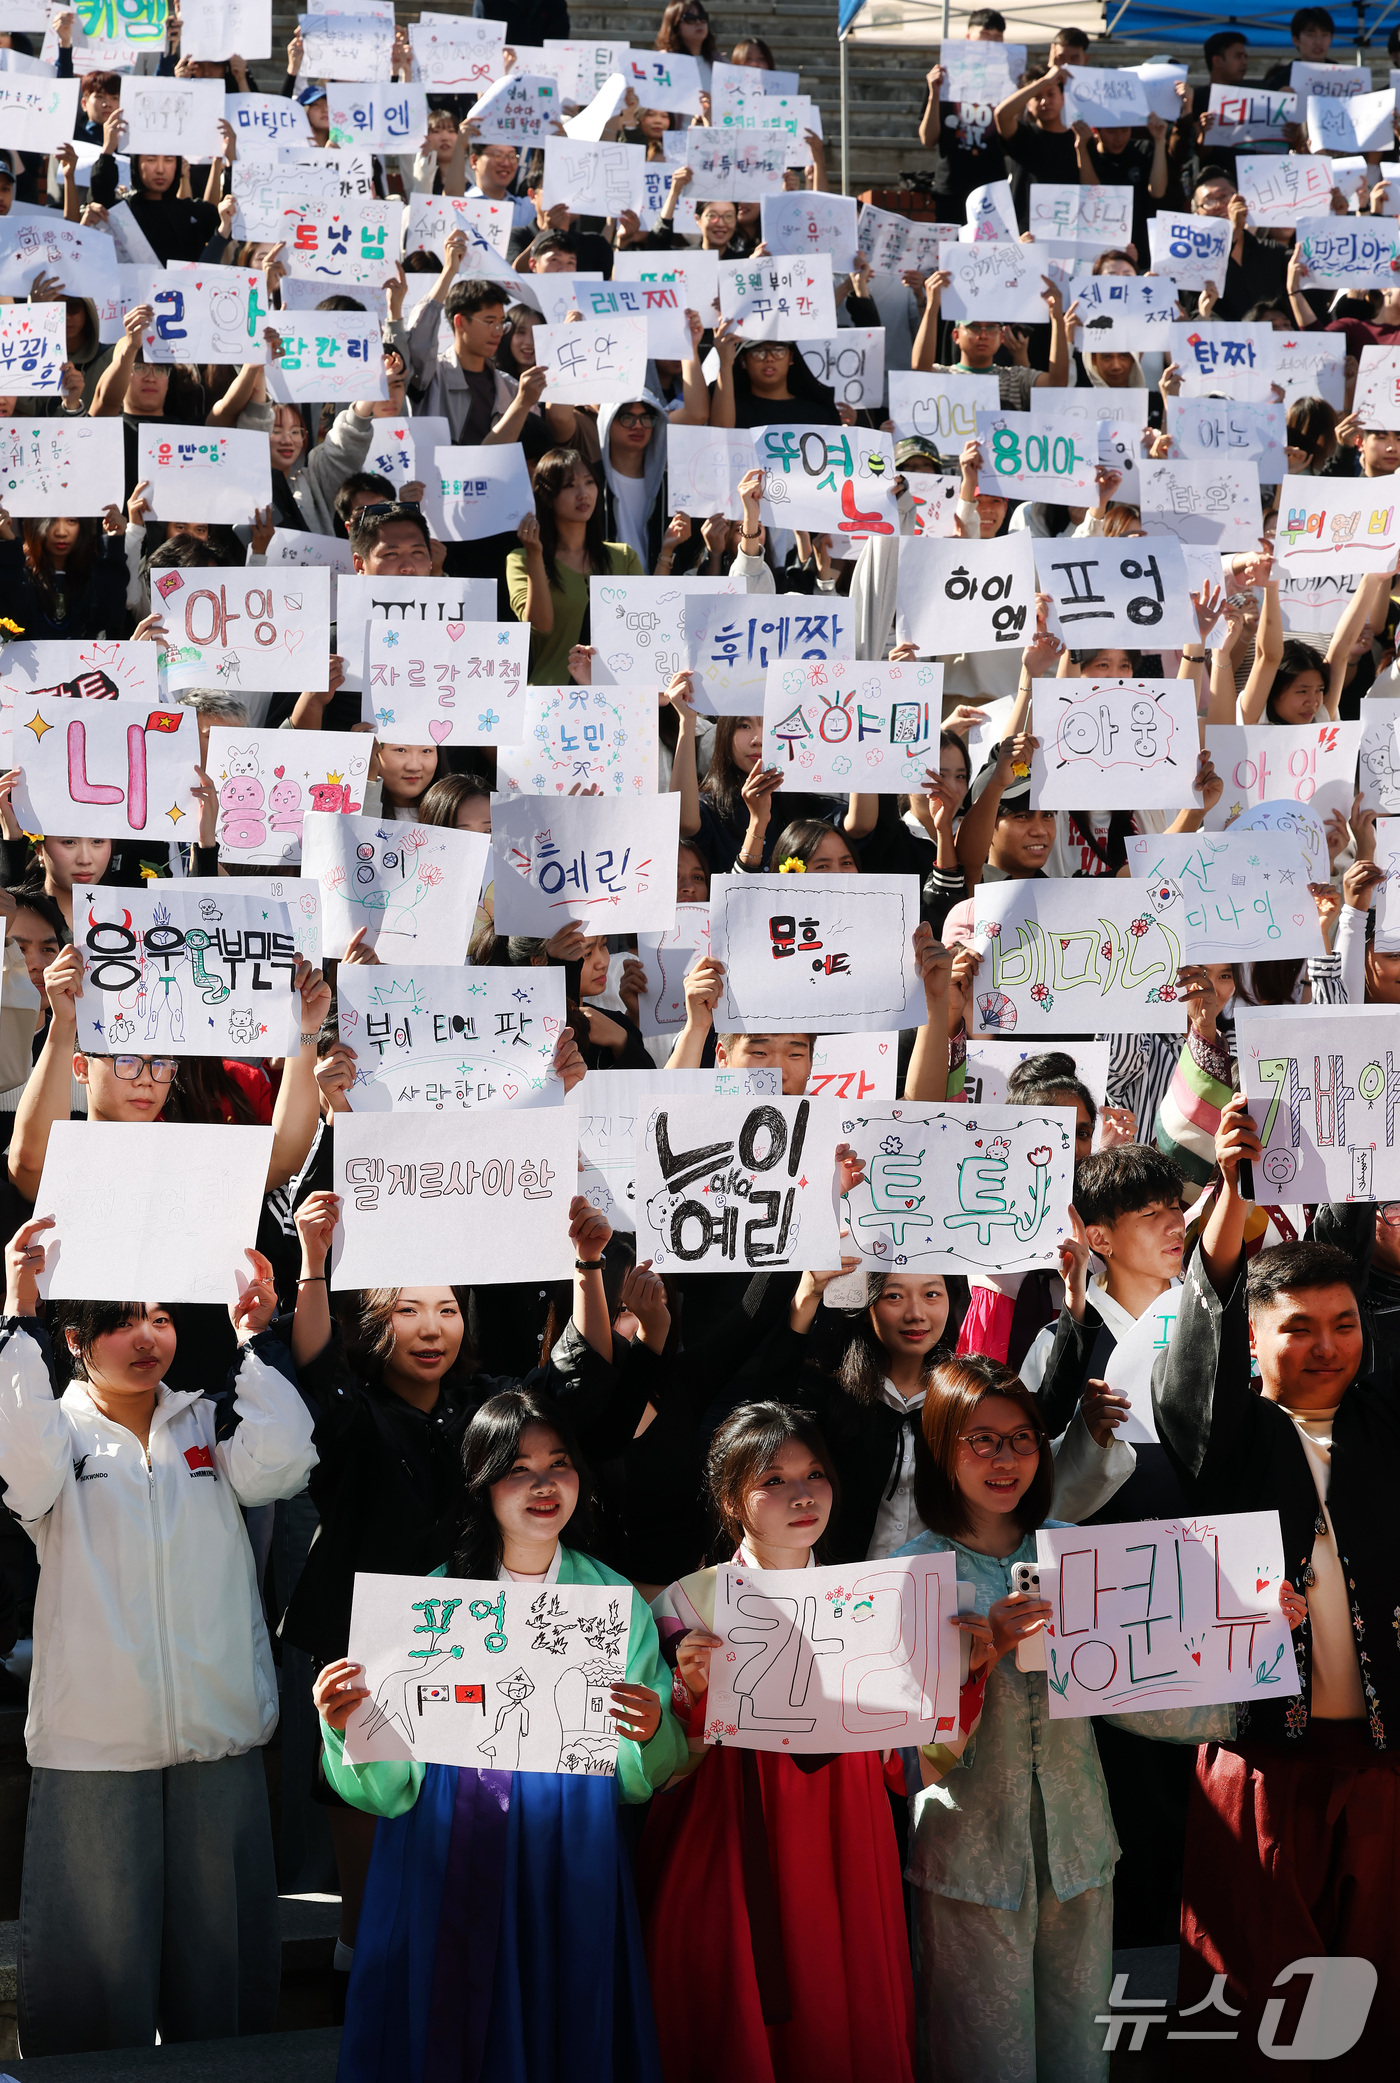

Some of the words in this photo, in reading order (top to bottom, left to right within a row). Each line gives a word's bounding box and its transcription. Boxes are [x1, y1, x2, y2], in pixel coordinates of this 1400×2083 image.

[238, 110, 297, 138] 마틸다
[294, 224, 388, 260] 도낫남
[1315, 234, 1389, 262] 마리아
[281, 336, 368, 370] 팜칸리
[1194, 341, 1256, 374] 탄짜
[1199, 420, 1250, 448] 아노
[1171, 485, 1230, 515] 타오
[1280, 506, 1326, 546] 부이
[1368, 506, 1394, 536] 비
[944, 566, 1013, 601] 하이
[185, 584, 277, 648] 아잉
[992, 605, 1027, 643] 엔
[561, 723, 604, 752] 노민
[1062, 702, 1158, 758] 아웅
[1232, 749, 1317, 802] 아잉
[537, 843, 632, 894] 혜린
[367, 1012, 412, 1056] 부이
[433, 1013, 479, 1043] 티엔
[494, 1011, 532, 1047] 팟
[398, 1081, 497, 1111] 사랑한다
[346, 1157, 555, 1211] 델게르사이한
